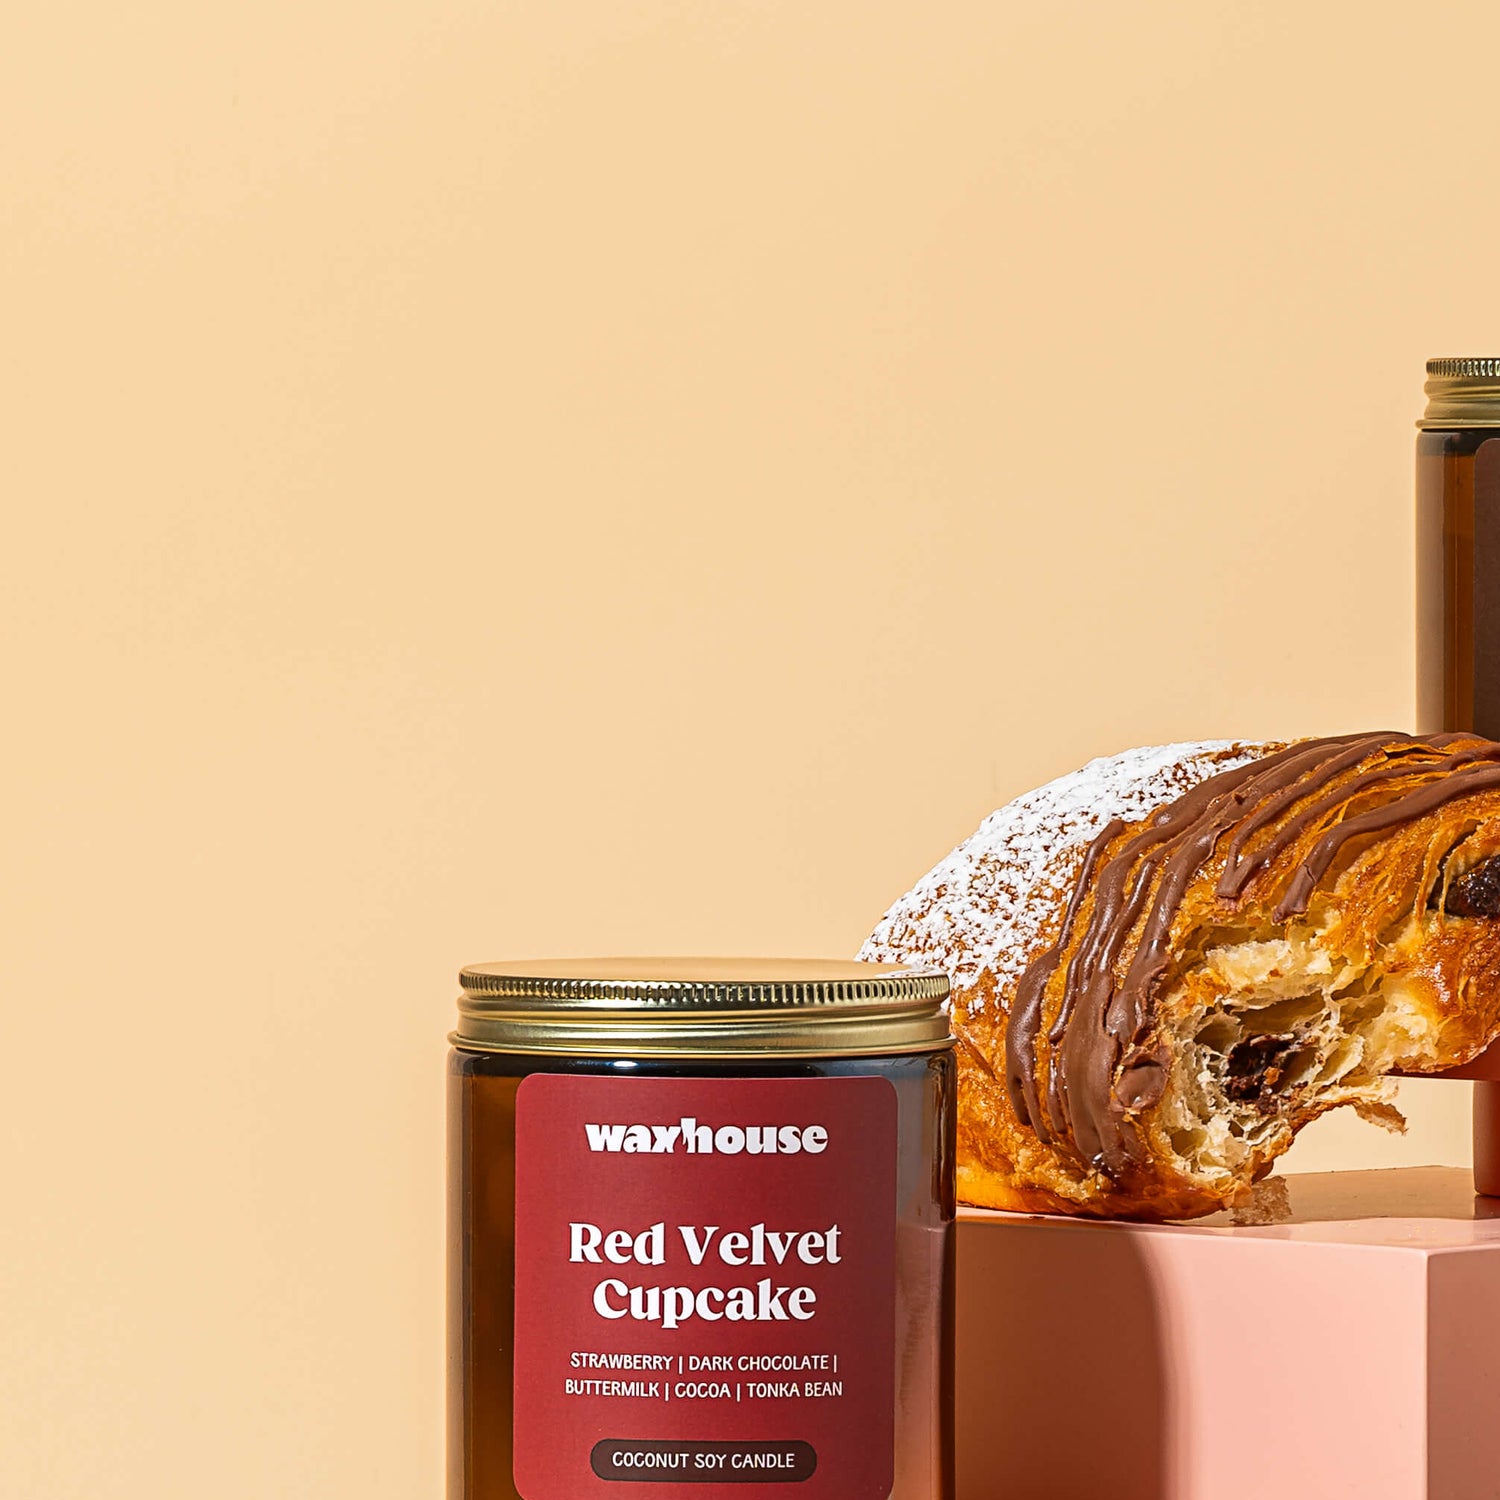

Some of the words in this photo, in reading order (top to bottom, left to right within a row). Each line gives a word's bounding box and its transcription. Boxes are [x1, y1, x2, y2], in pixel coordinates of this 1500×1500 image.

[585, 1118, 827, 1154] waxhouse
[569, 1222, 665, 1265] Red
[678, 1223, 841, 1265] Velvet
[594, 1279, 816, 1328] Cupcake
[569, 1352, 673, 1371] STRAWBERRY
[688, 1355, 733, 1371] DARK
[737, 1354, 828, 1372] CHOCOLATE
[565, 1378, 659, 1399] BUTTERMILK
[674, 1382, 731, 1399] COCOA
[746, 1382, 800, 1398] TONKA
[804, 1381, 842, 1397] BEAN
[612, 1451, 689, 1469] COCONUT
[693, 1453, 726, 1469] SOY
[731, 1453, 794, 1469] CANDLE
